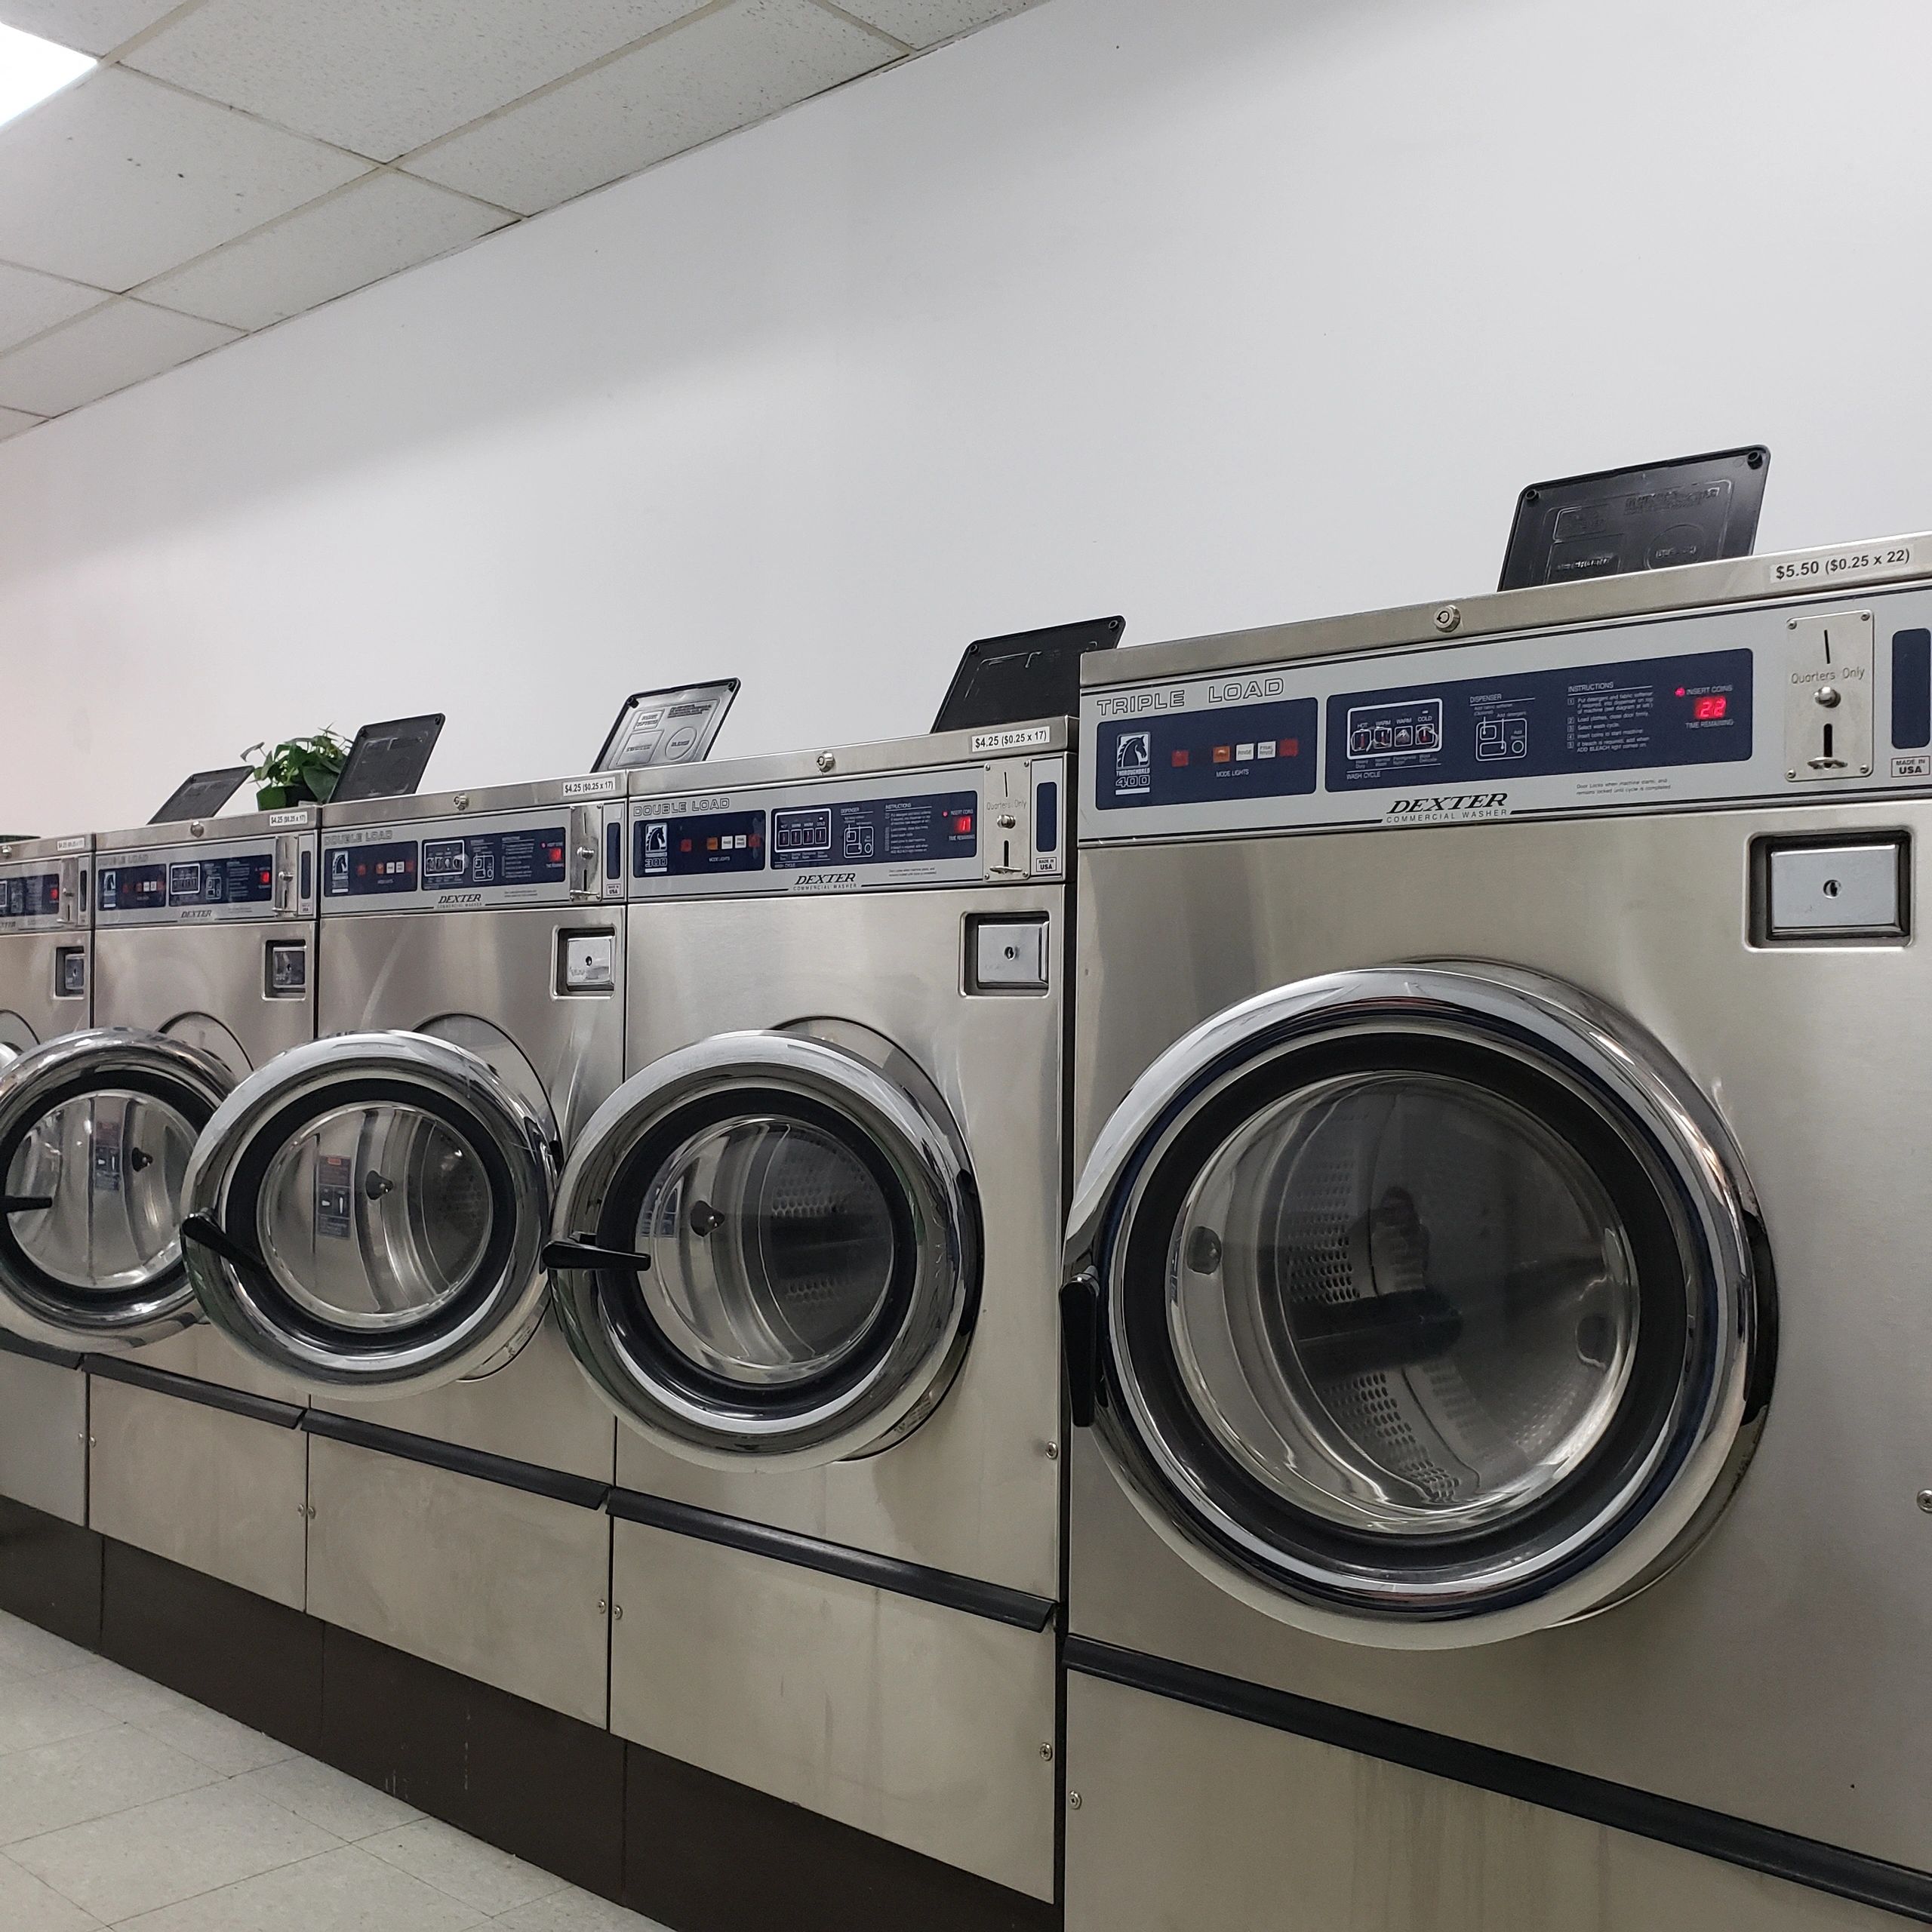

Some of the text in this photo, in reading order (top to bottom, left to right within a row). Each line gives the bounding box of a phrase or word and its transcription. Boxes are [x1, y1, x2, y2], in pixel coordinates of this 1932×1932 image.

[1776, 548, 1910, 580] $5.50 ($0.25 x 22)
[1791, 666, 1865, 685] Quarters Only
[1567, 681, 1614, 692] INSTRUCTIONS
[1097, 678, 1284, 716] TRIPLE LOAD
[1469, 694, 1502, 703] DISPENSER
[1700, 698, 1726, 718] 22
[975, 736, 998, 749] $4.25
[1001, 733, 1025, 746] ($0.25
[1035, 731, 1047, 741] 17)
[1899, 765, 1922, 774] USA
[565, 783, 581, 793] $4.25
[583, 782, 599, 792] ($0.25
[605, 780, 614, 790] 17)
[1115, 774, 1150, 788] 400
[633, 798, 730, 817] DOUBLE LOAD
[986, 801, 1011, 811] Quarters
[1386, 792, 1508, 814] DEXTER
[1386, 809, 1507, 823] COMMERCIAL WASHER
[365, 830, 392, 841] LOAD
[795, 873, 856, 885] DEXTER
[438, 894, 481, 903] DEXTER
